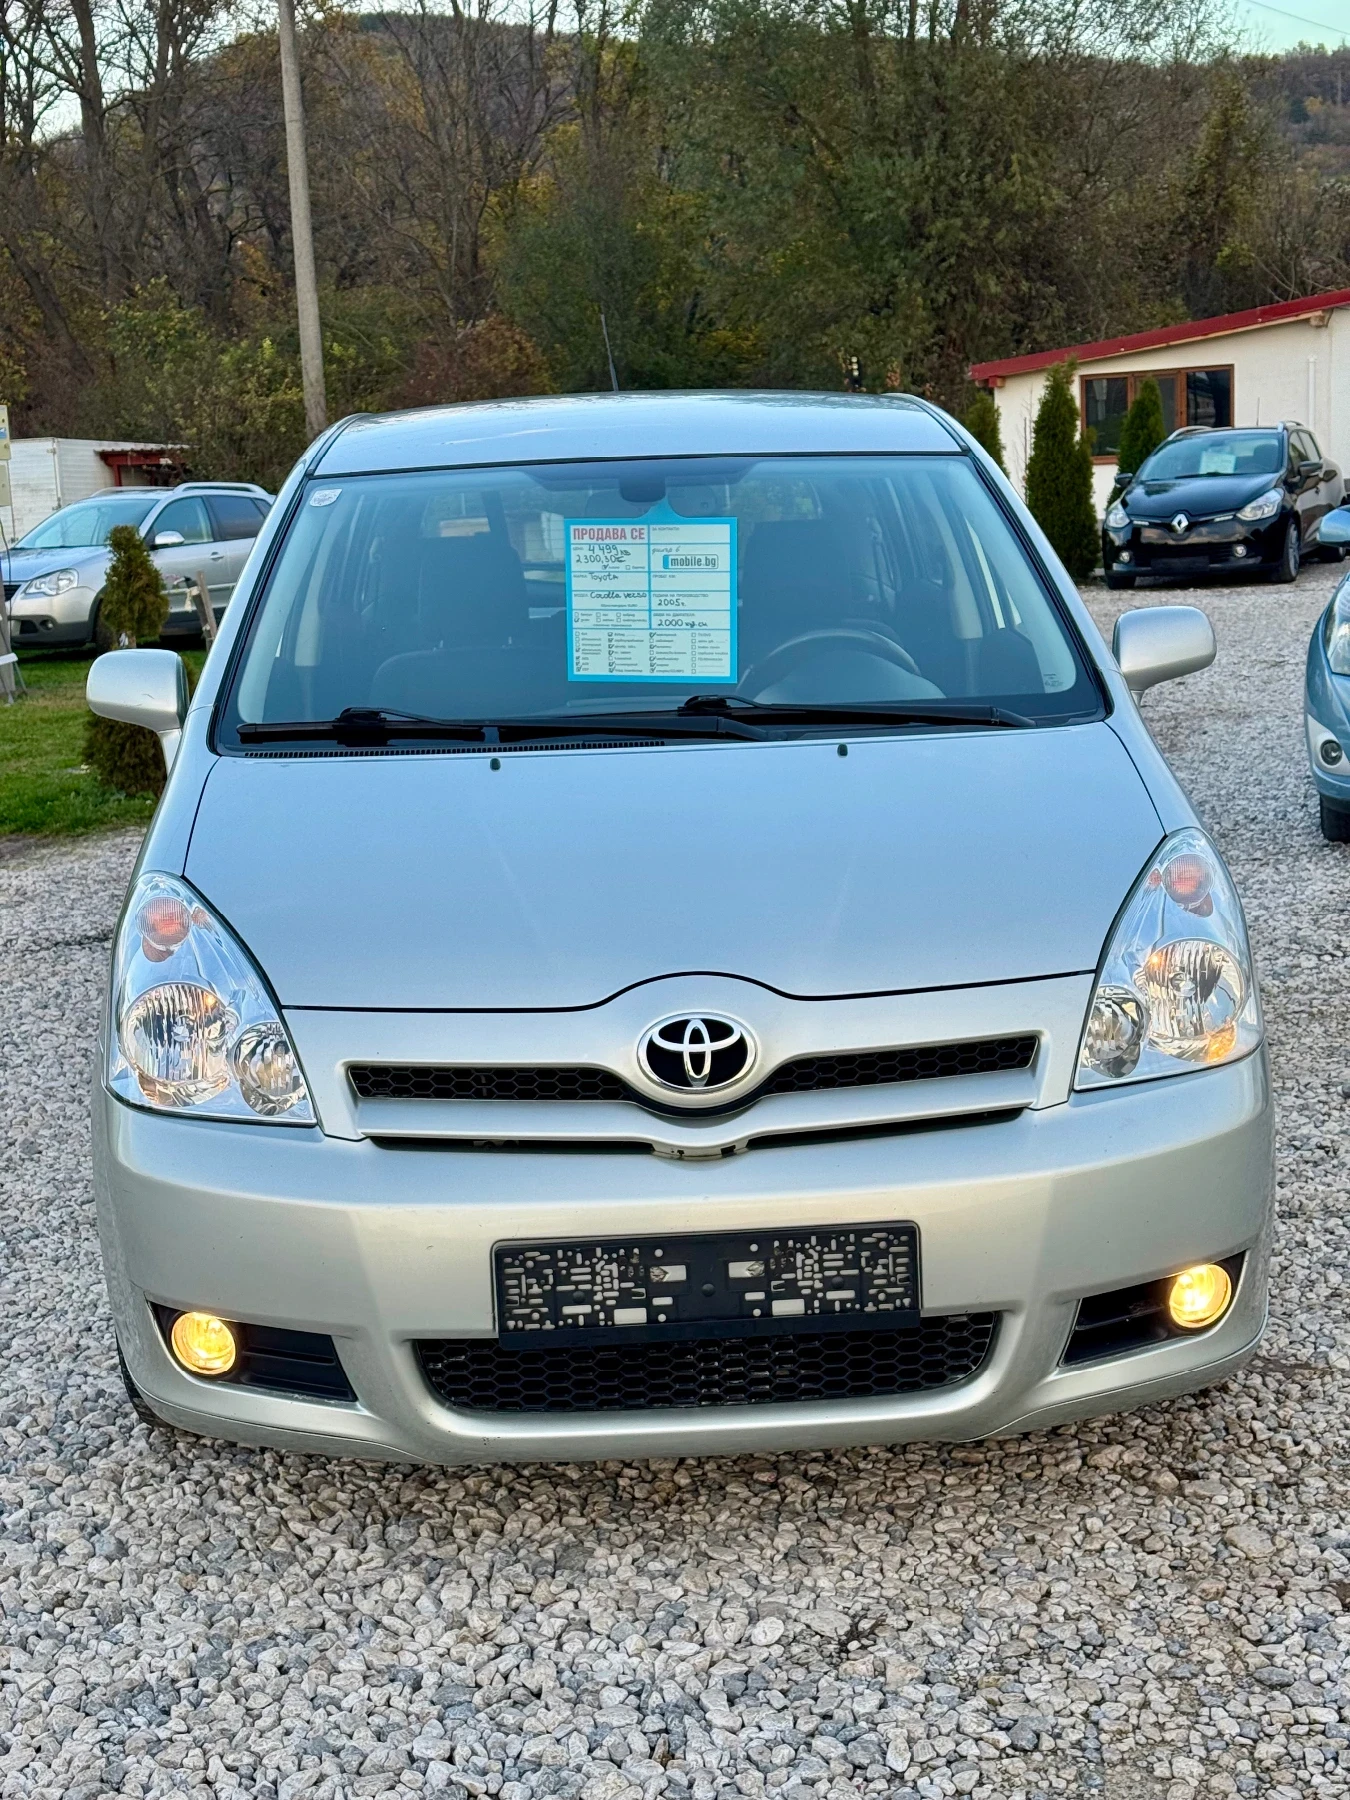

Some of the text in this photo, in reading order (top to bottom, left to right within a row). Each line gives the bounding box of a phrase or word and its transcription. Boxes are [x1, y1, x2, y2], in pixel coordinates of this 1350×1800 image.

[573, 528, 645, 541] ПРОДАВА СЕ
[670, 556, 716, 568] mobile.bg
[588, 572, 619, 582] Toyota
[657, 618, 684, 627] 2000
